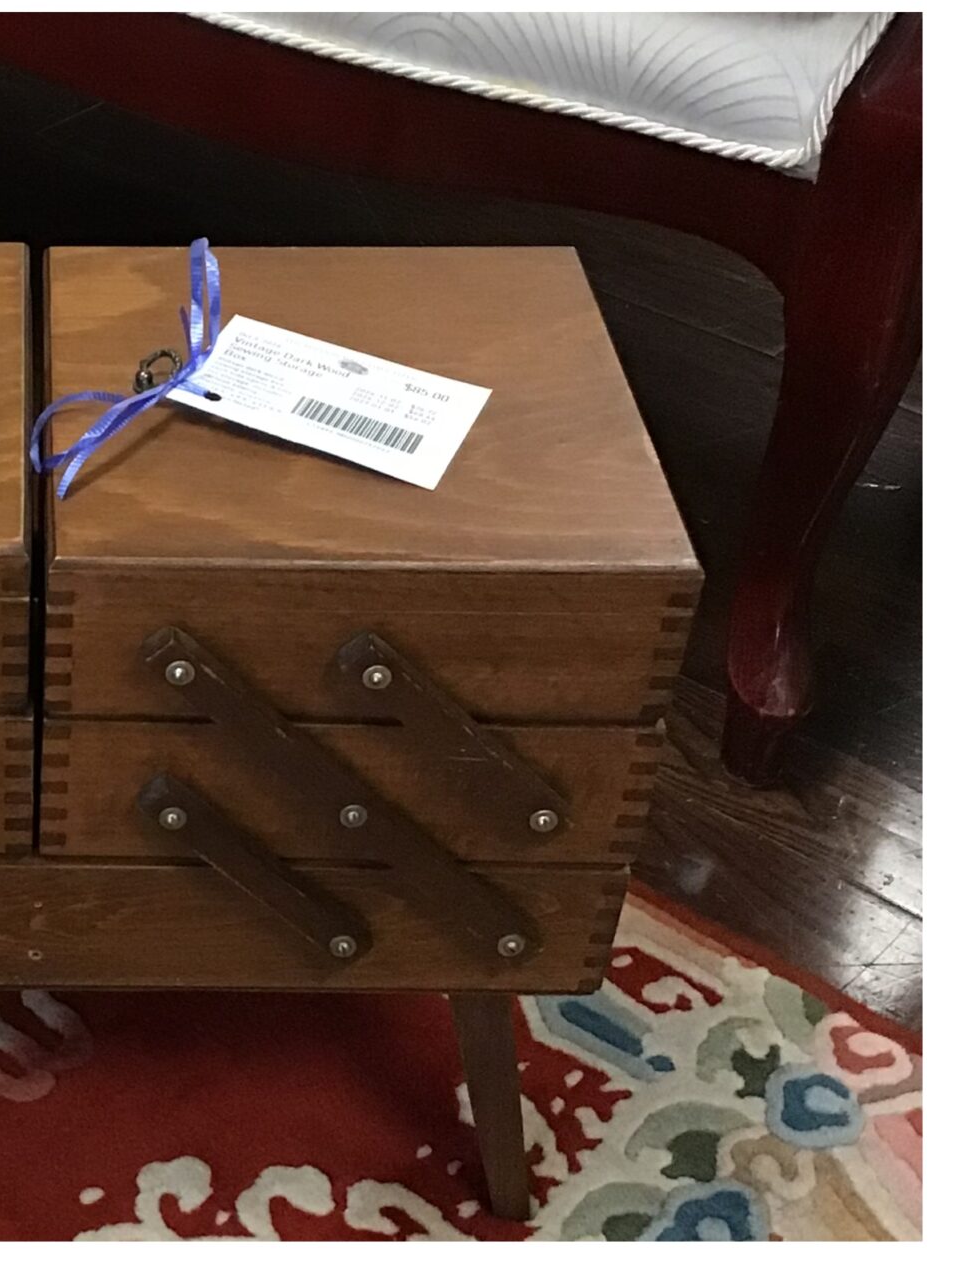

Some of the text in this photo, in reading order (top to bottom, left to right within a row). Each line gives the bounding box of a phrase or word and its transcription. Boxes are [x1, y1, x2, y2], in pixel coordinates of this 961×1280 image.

[223, 348, 246, 361] Box
[227, 343, 272, 362] Sewing
[276, 358, 323, 377] Storage
[234, 336, 280, 355] Vintage
[282, 352, 312, 366] Dark
[316, 362, 351, 378] Wood
